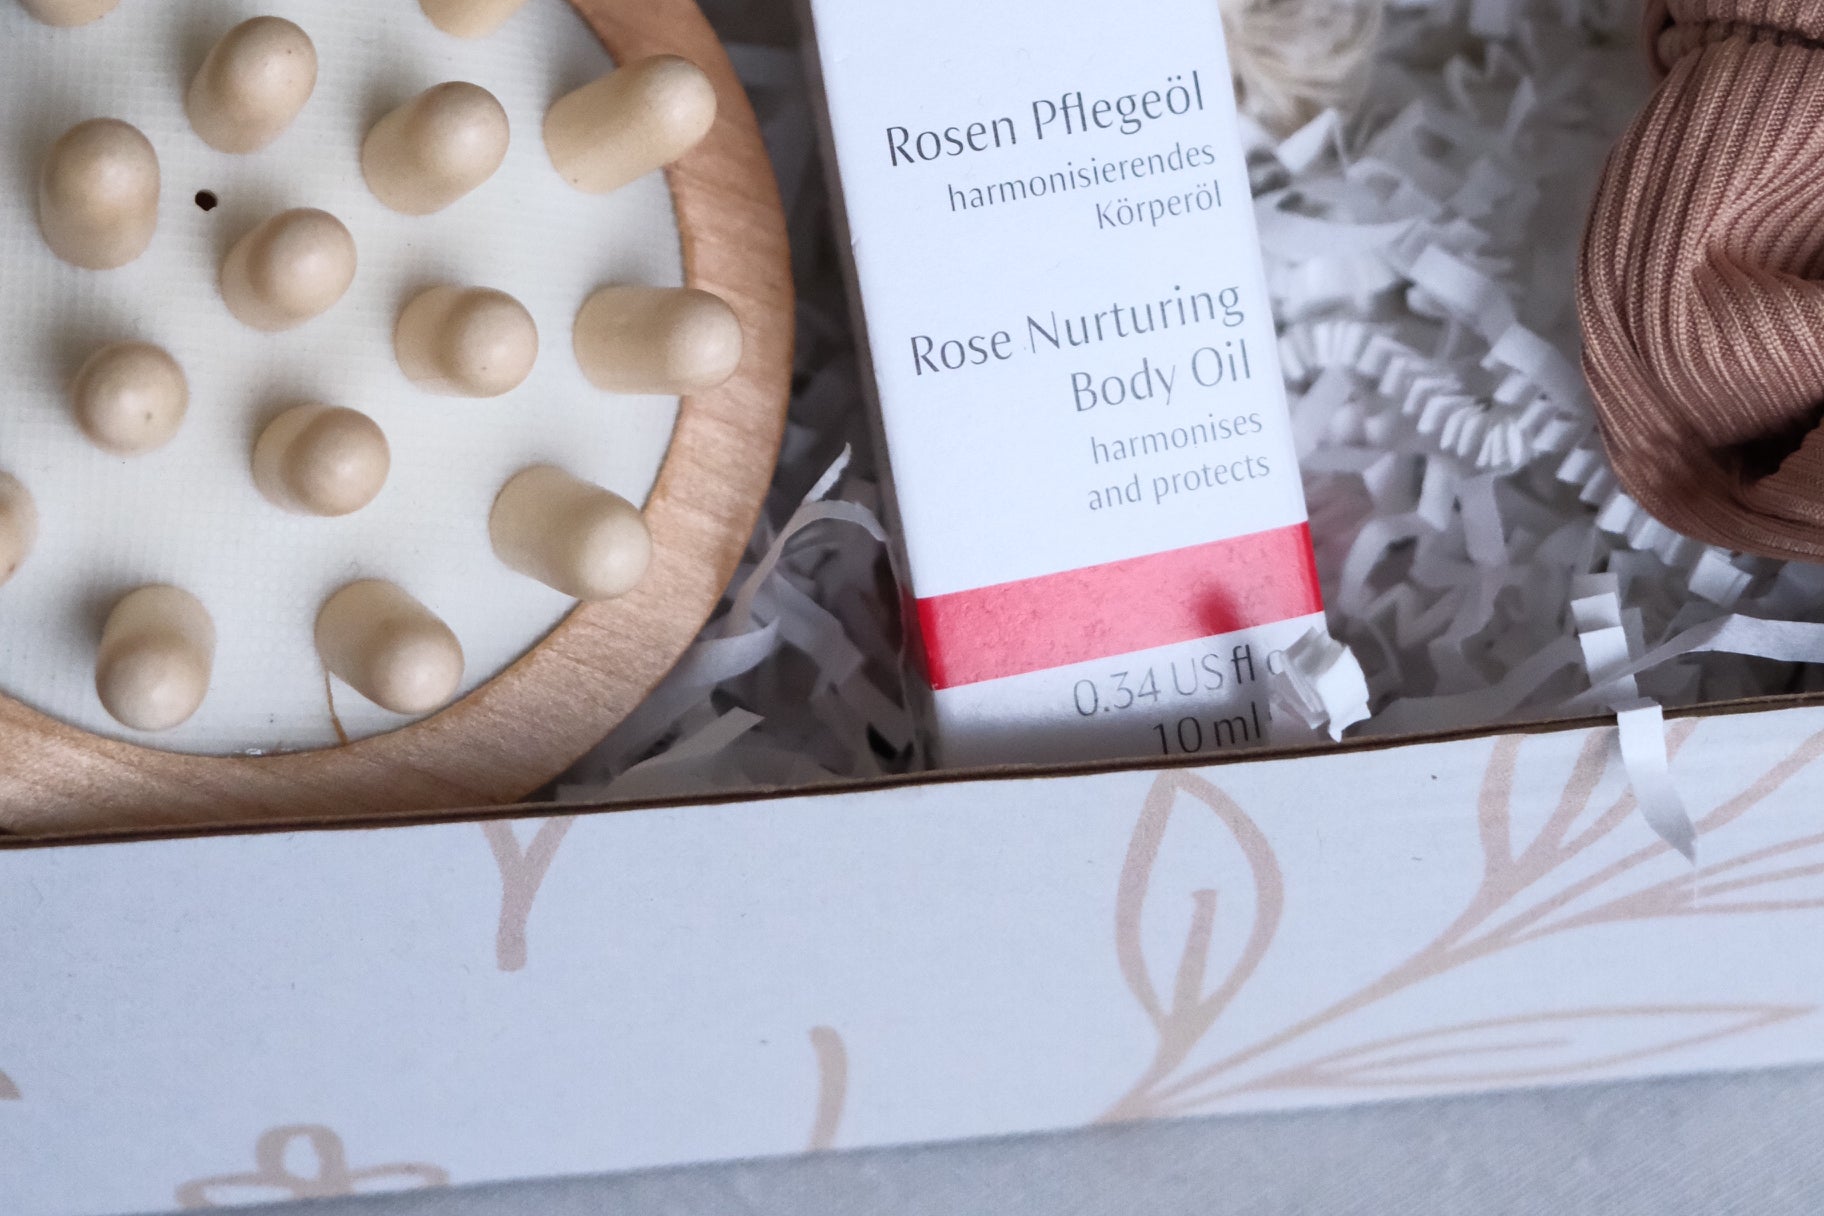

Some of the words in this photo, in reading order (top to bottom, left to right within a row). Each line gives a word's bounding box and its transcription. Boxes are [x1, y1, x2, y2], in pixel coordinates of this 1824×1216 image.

[886, 115, 1017, 167] Rosen
[1032, 70, 1204, 140] Pflegeöl
[947, 141, 1216, 212] harmonisierendes
[1095, 179, 1222, 229] Körperöl
[910, 330, 1013, 376] Rose
[1026, 285, 1245, 355] Nurturing
[1071, 357, 1176, 412] Body
[1191, 339, 1251, 387] Oil
[1090, 412, 1263, 465] harmonises
[1088, 473, 1142, 510] and
[1153, 453, 1271, 504] protects
[1073, 667, 1161, 717] 0.34
[1171, 653, 1223, 696] US
[1230, 644, 1256, 684] fl
[1153, 716, 1202, 755] 10
[1213, 701, 1261, 748] ml
